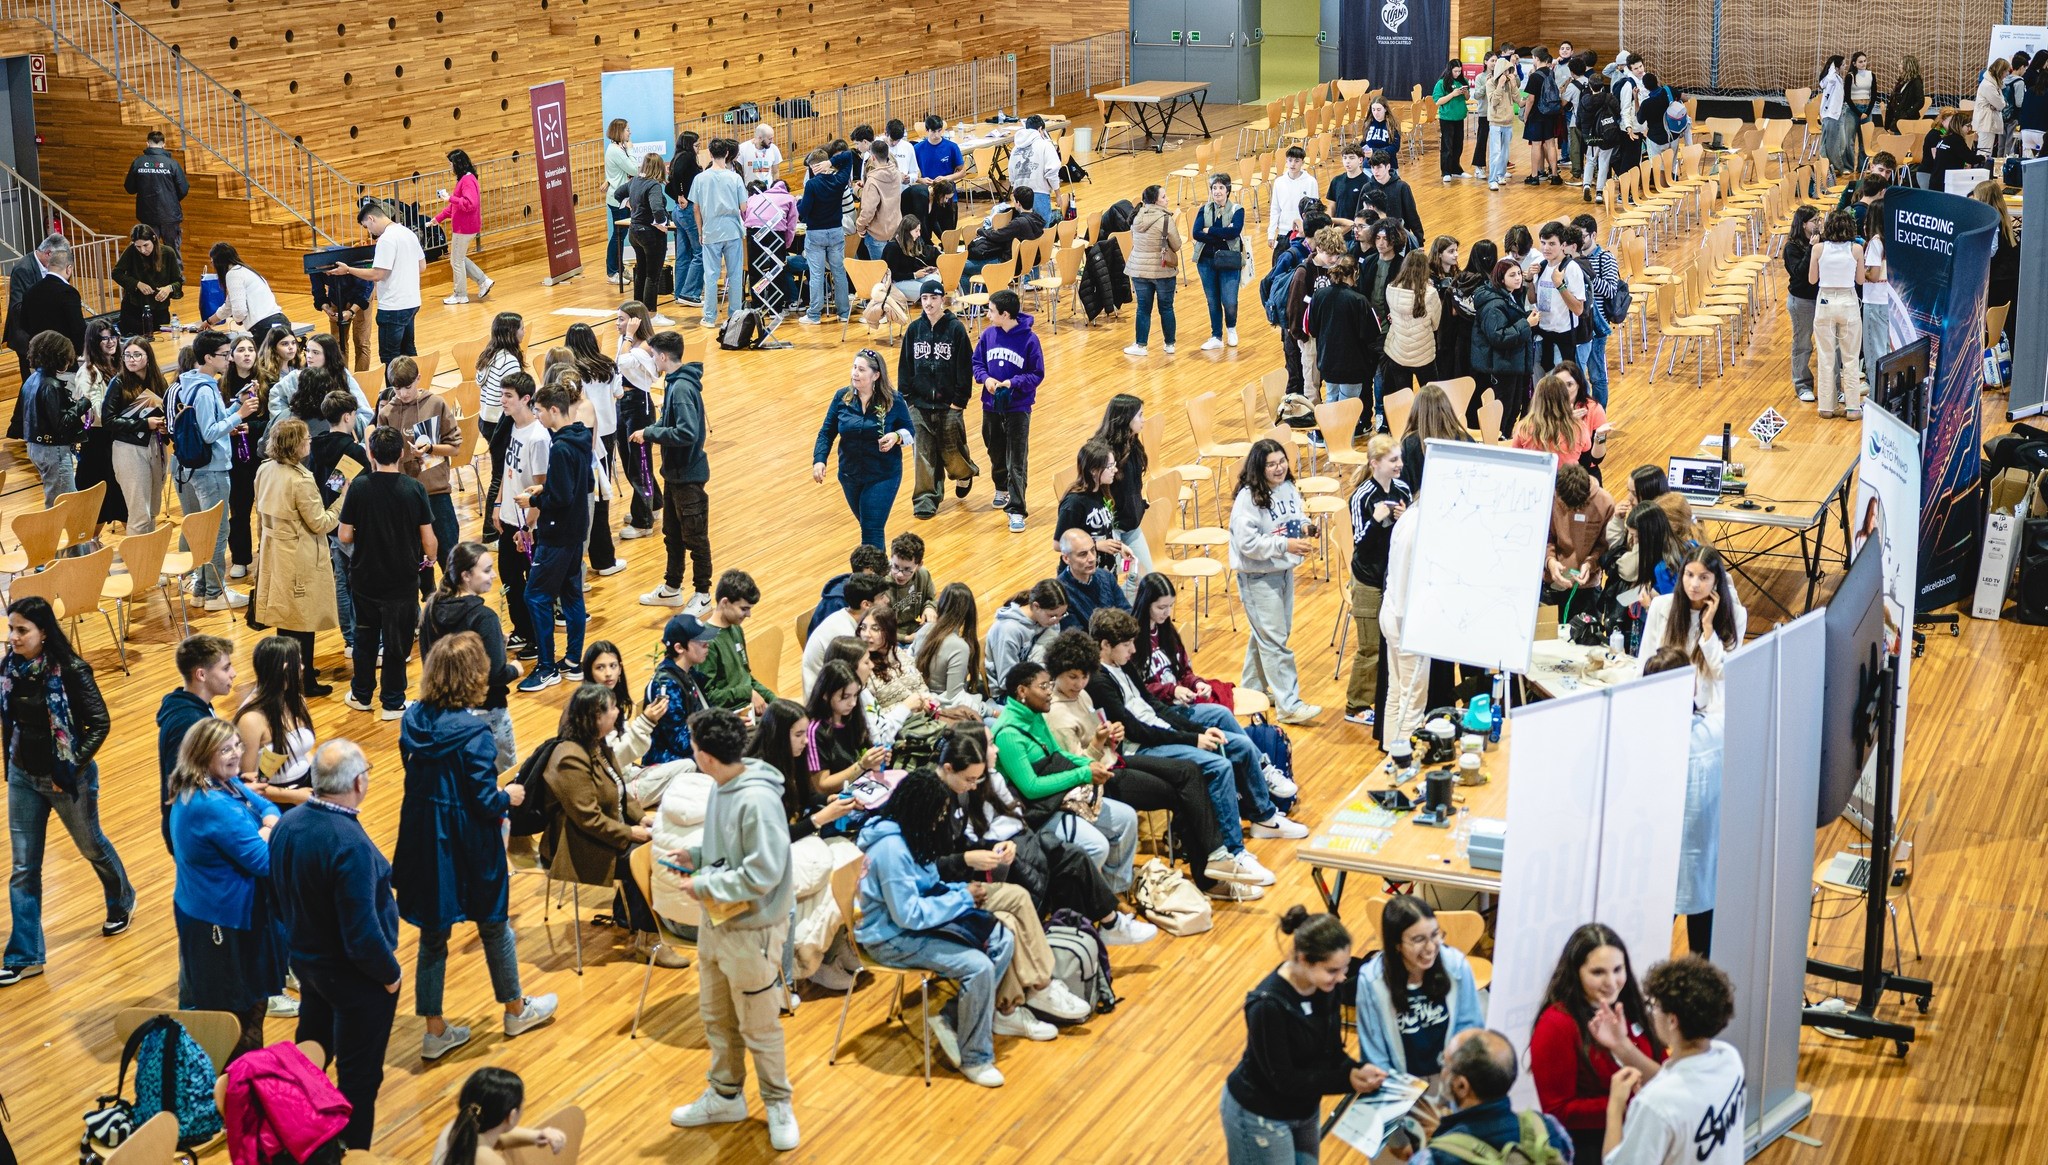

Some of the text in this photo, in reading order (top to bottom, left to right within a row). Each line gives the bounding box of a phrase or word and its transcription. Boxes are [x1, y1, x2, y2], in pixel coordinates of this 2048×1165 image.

[1366, 126, 1389, 142] GAP
[544, 166, 567, 178] Universidade
[1898, 210, 1954, 235] EXCEEDING
[1921, 573, 1957, 595] alticelabs.com
